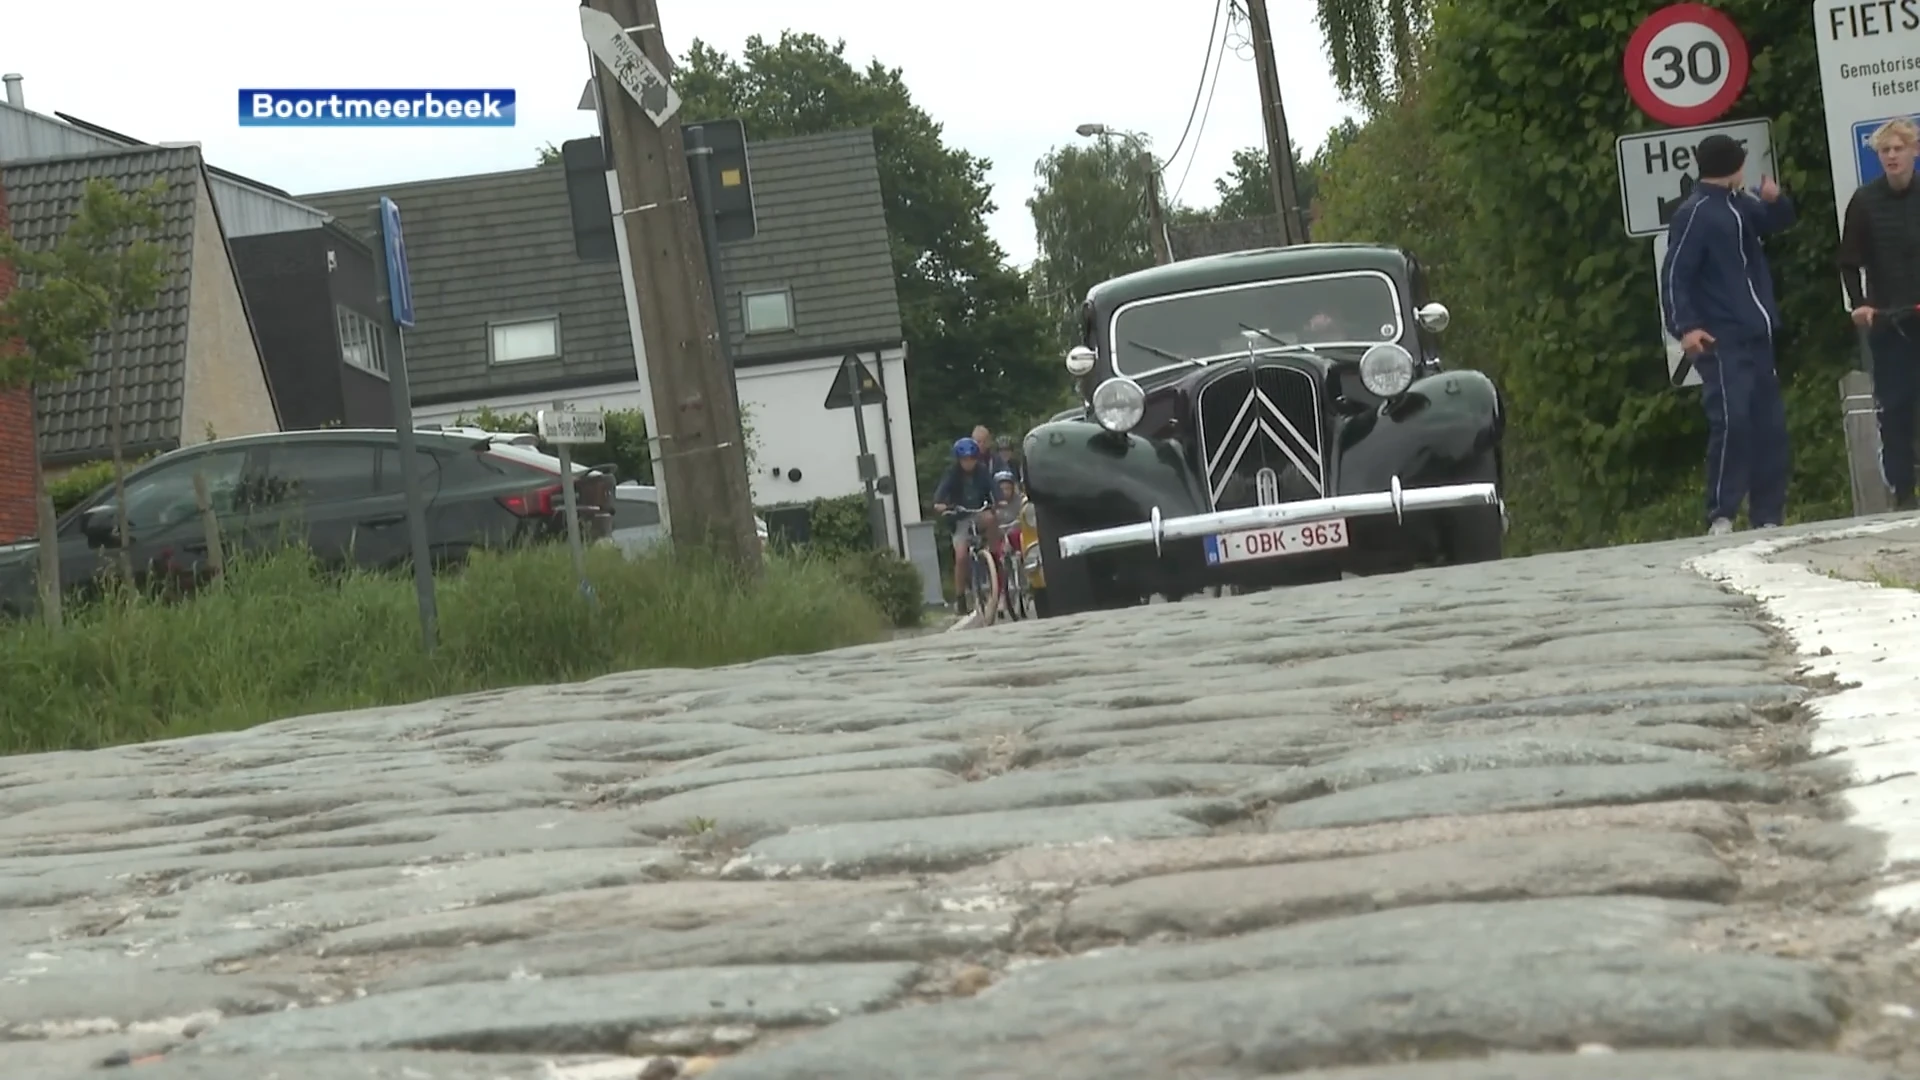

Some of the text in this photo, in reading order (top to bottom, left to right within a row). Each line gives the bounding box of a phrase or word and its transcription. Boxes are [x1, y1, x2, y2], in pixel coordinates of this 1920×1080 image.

[1829, 0, 1920, 40] FIETS
[1653, 41, 1721, 89] 30
[1220, 522, 1343, 558] 1-OBK-963
